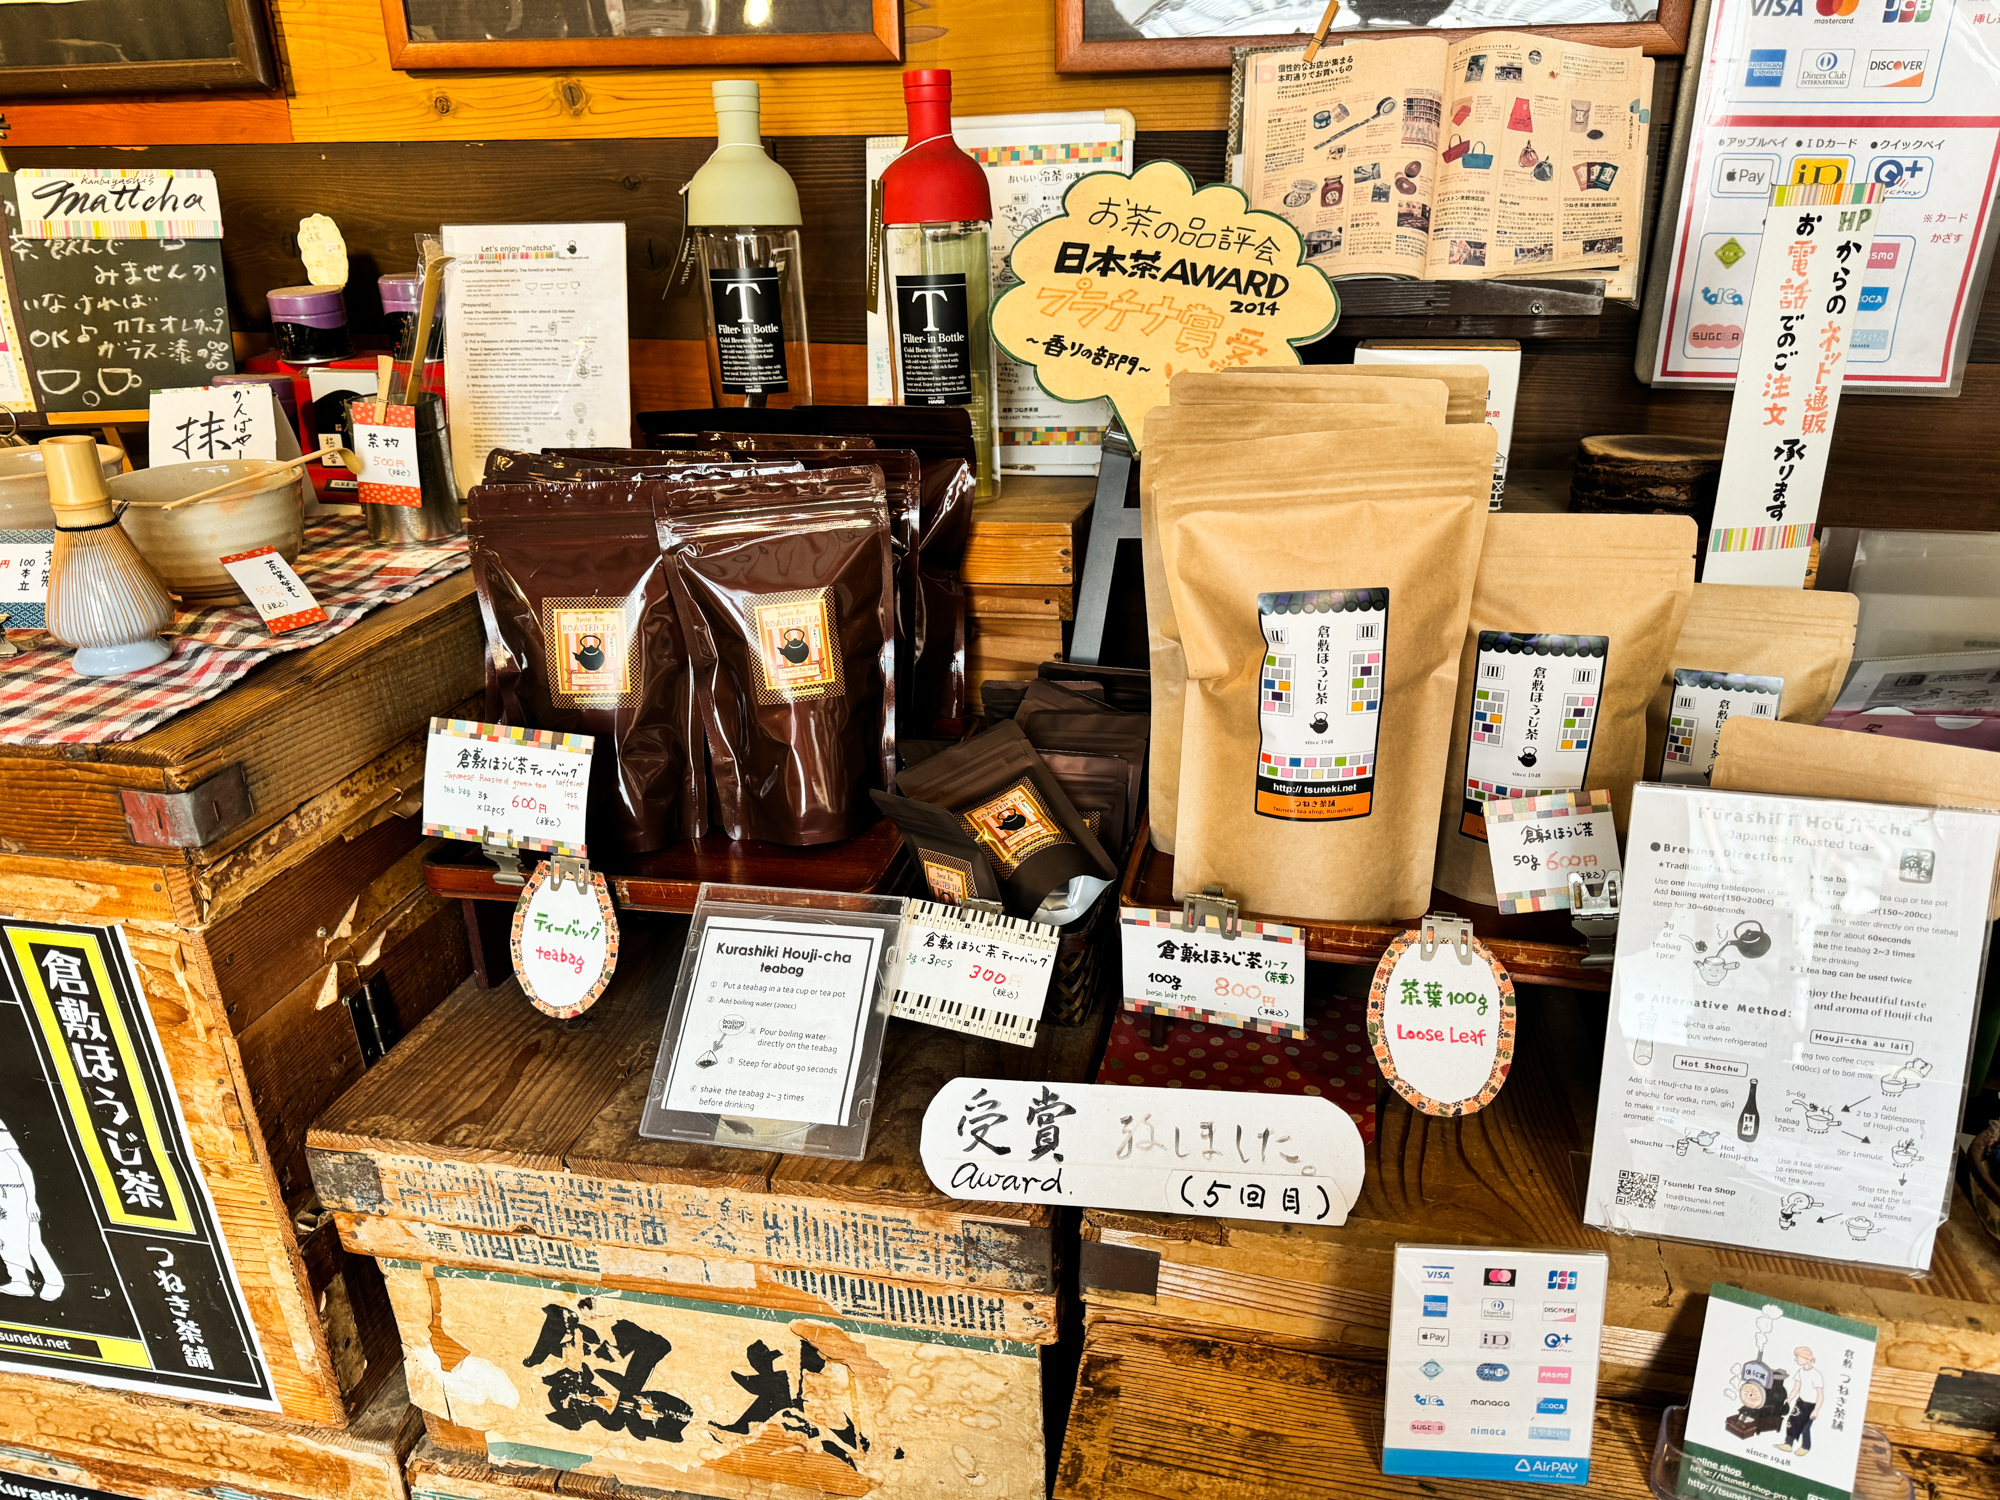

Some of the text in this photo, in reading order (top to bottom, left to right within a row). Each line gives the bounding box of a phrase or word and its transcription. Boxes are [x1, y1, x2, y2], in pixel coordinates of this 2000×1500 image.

[1869, 60, 1923, 71] DISCOVER
[1802, 70, 1847, 80] Diners Club
[1879, 139, 1946, 150] クイックペイ
[1738, 168, 1765, 185] Pay
[1088, 197, 1281, 266] お茶の品評会
[481, 245, 520, 254] Let's enjoy
[94, 259, 217, 286] みませんか
[1053, 241, 1290, 299] 日本茶AWARD
[1229, 301, 1281, 316] 2014
[1036, 278, 1225, 359] プラチナ賞
[753, 323, 779, 334] Bottle
[938, 332, 965, 343] Bottle
[172, 410, 232, 460] 抹
[1765, 438, 1807, 522] 承ります
[562, 624, 618, 632] ROASTED TEA
[765, 615, 820, 628] ROASTED TEA
[1315, 624, 1331, 705] 倉敷ほうじ茶
[1525, 665, 1547, 741] 倉敷ほうじ茶
[564, 791, 578, 799] less
[1304, 783, 1357, 794] tsuneki.net
[511, 795, 547, 814] 600円
[566, 802, 580, 811] tea
[1520, 822, 1594, 845] 倉敷ほうじ茶
[1664, 843, 1715, 858] Brewing
[1513, 854, 1541, 870] 50g
[1546, 851, 1598, 871] 600円
[533, 912, 602, 940] ティーバッグ
[1867, 934, 1912, 945] 60seconds
[535, 945, 585, 974] teabag
[716, 942, 852, 963] Kurashiki Houji-cha
[1157, 940, 1263, 969] 倉敷ほうじ茶
[760, 962, 804, 977] teabag
[1147, 972, 1182, 990] 100g
[723, 982, 735, 990] Put
[743, 984, 767, 993] teabag
[796, 988, 809, 996] cup
[819, 989, 831, 997] tea
[1214, 977, 1276, 1008] 800円
[733, 998, 754, 1007] boiling
[1830, 990, 1927, 1009] the beautiful taste
[1736, 1003, 1792, 1018] Method:
[1813, 1002, 1834, 1012] and
[1835, 1005, 1869, 1016] aroma
[1870, 1006, 1882, 1017] of
[759, 1028, 777, 1036] Pour
[778, 1029, 803, 1040] boiling
[1397, 1023, 1487, 1046] Loose Leaf
[757, 1039, 785, 1050] directly
[811, 1044, 838, 1054] teabag
[1724, 1037, 1768, 1049] refrigerated
[1815, 1033, 1868, 1046] Houji-cha
[1890, 1042, 1909, 1051] lait
[738, 1058, 838, 1074] Steep for about seconds
[1680, 1059, 1739, 1073] Hot Shochu
[42, 949, 164, 1210] 倉敷ほうじ茶
[700, 1085, 805, 1102] shake the teabag times
[699, 1098, 755, 1111] before drinking
[955, 1085, 1078, 1164] 受賞
[1662, 1179, 1737, 1197] Tsuneki Tea Shop
[1665, 1192, 1726, 1207] tea@tsuneki.net
[1663, 1203, 1726, 1217] http://tsuneki.net
[1426, 1271, 1450, 1279] VISA
[1548, 1276, 1577, 1285] JCB
[146, 1246, 214, 1371] つねき茶舗
[1544, 1306, 1576, 1314] DISCOVER
[1429, 1332, 1446, 1343] Pay
[1541, 1371, 1569, 1380] PASMO
[1470, 1398, 1511, 1407] manaca
[1470, 1426, 1506, 1436] nimoca
[1745, 1447, 1791, 1467] since 1948
[1532, 1461, 1579, 1474] AirPAY
[1720, 1463, 1742, 1477] shop
